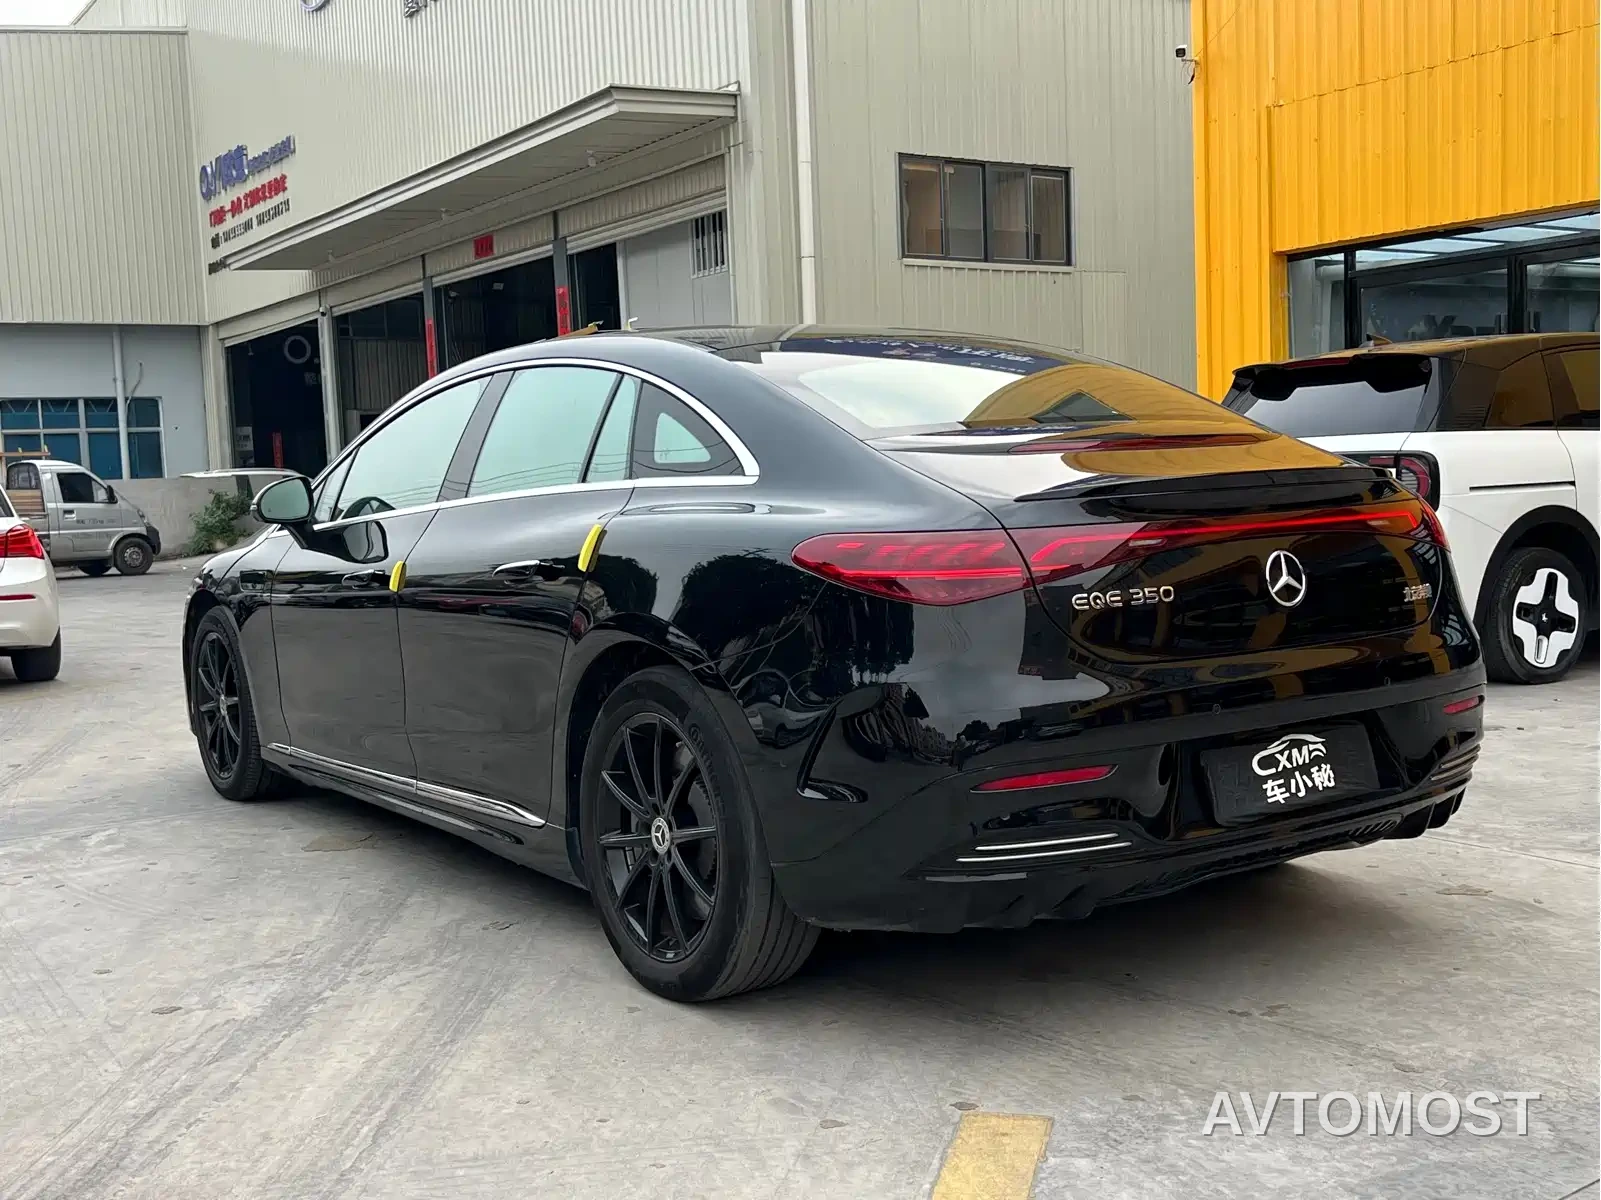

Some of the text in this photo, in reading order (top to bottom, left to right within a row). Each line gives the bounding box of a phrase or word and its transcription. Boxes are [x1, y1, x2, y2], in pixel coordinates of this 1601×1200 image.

[1071, 585, 1175, 611] EQE 350
[1262, 763, 1336, 804] 车小秘
